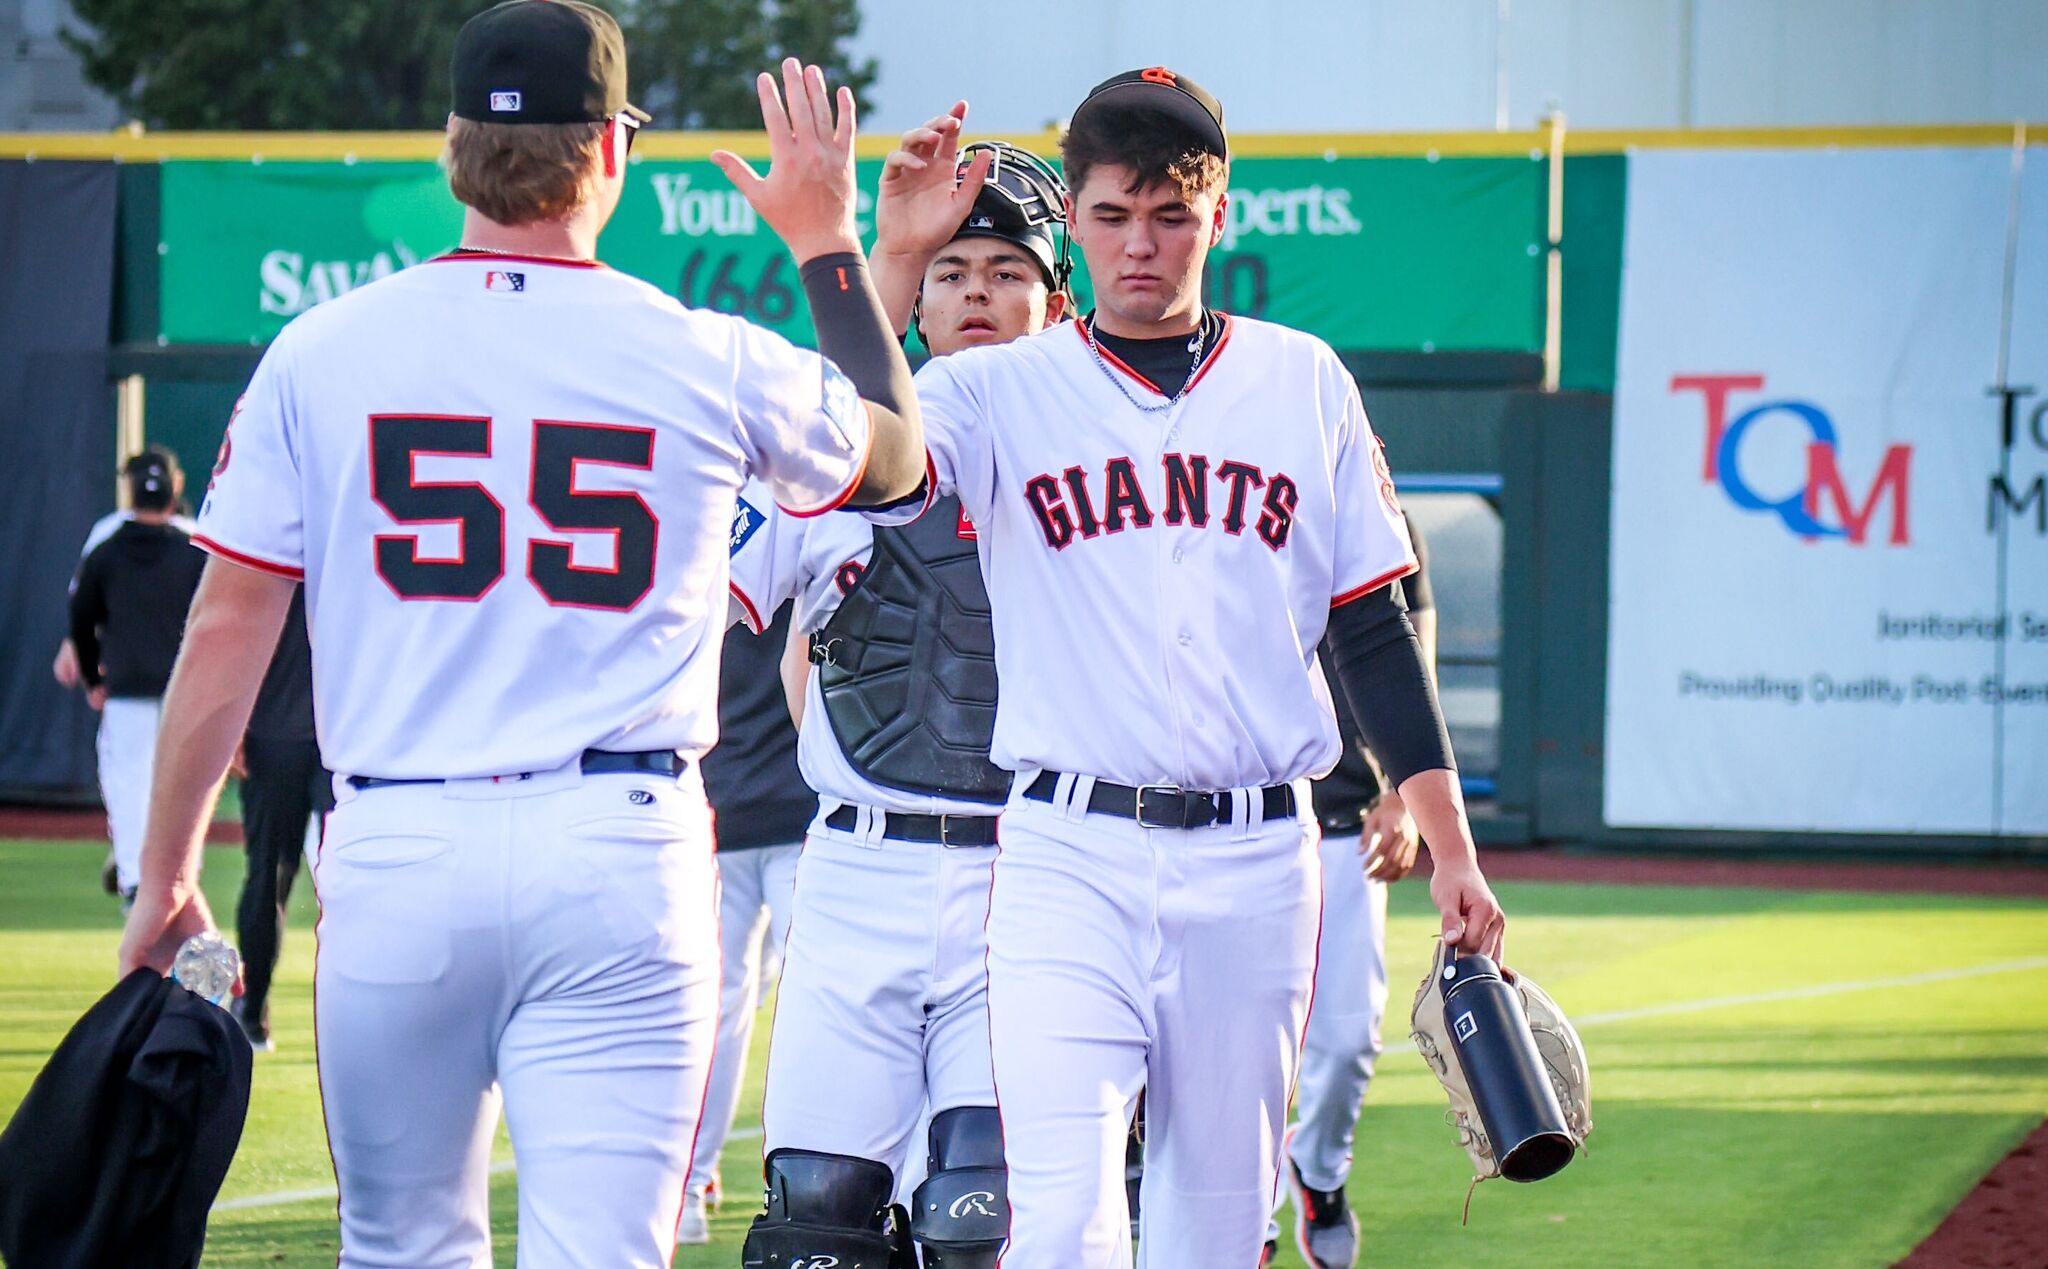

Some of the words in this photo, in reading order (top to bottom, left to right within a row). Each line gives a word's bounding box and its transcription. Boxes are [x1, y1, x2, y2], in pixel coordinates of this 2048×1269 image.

[368, 414, 659, 612] 55
[1025, 453, 1298, 551] GIANTS
[1670, 374, 1912, 546] TQM
